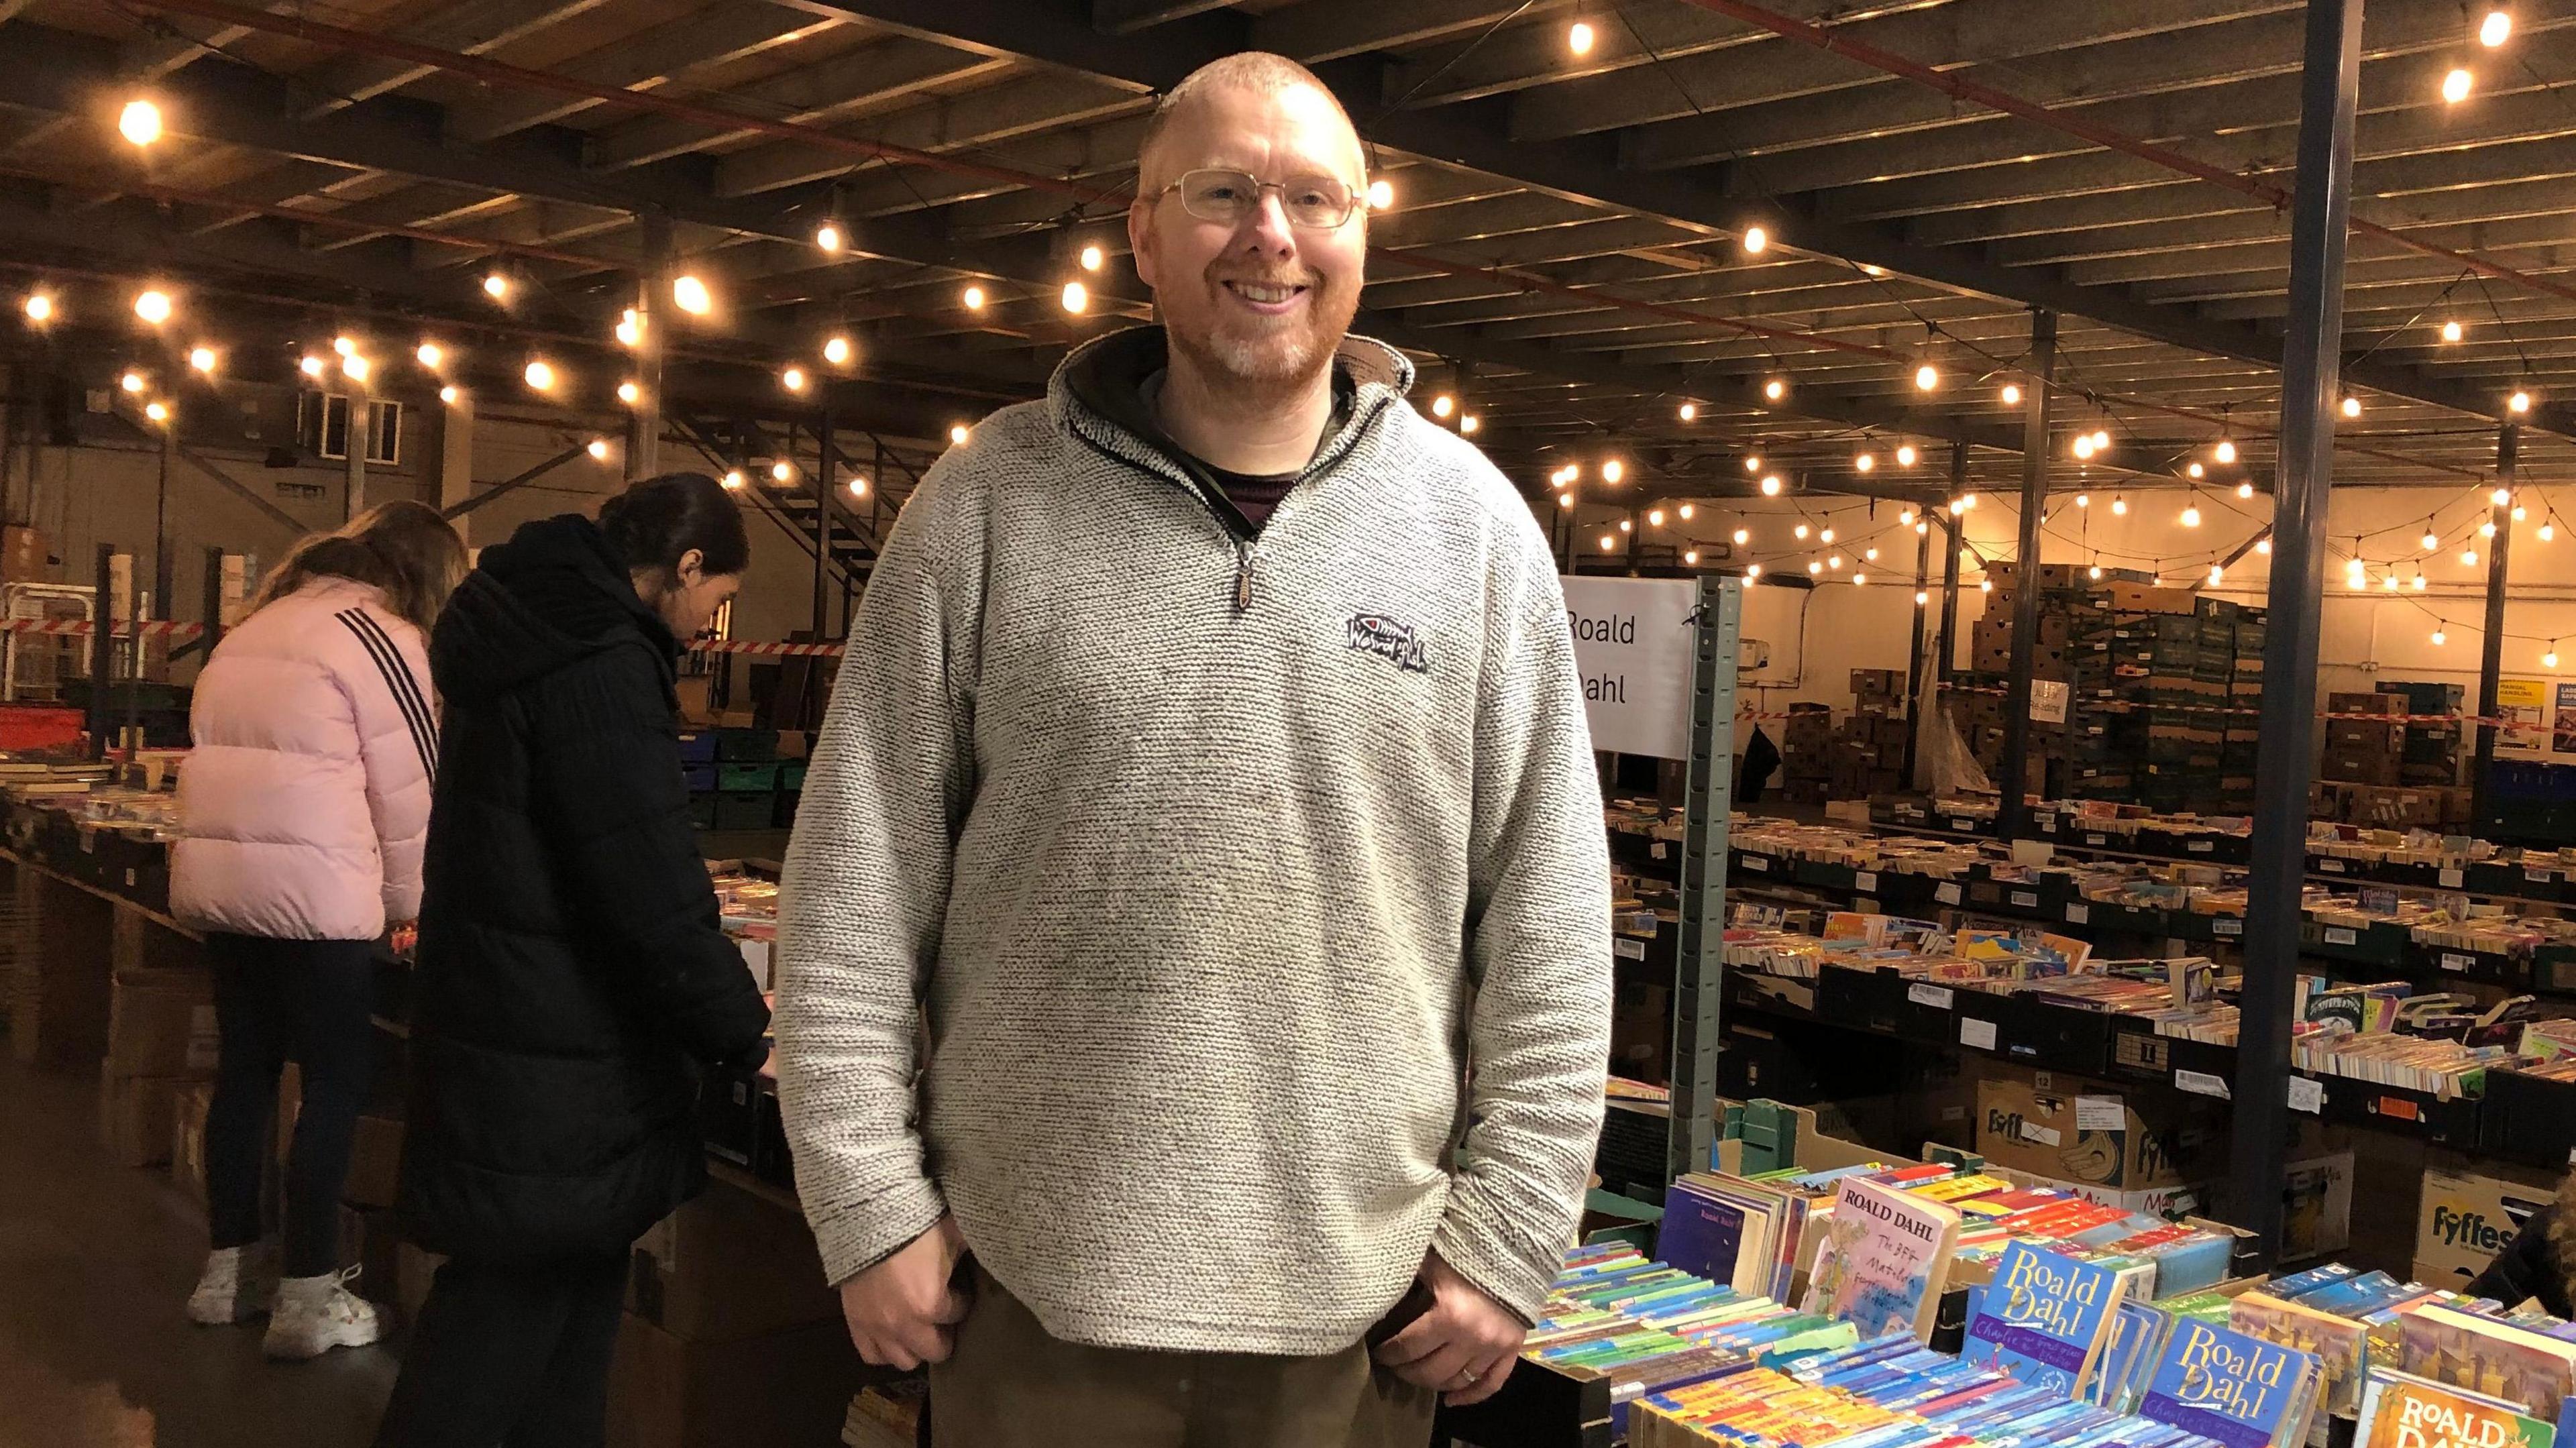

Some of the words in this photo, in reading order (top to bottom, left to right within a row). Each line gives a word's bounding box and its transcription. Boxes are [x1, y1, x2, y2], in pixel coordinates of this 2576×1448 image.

[1348, 620, 1397, 659] Weird
[1568, 611, 1635, 644] Roald
[2038, 1077, 2049, 1087] 12
[1845, 1190, 1892, 1221] ROALD
[1894, 1213, 1933, 1243] DAHL
[2432, 1206, 2514, 1251] fyffes
[1866, 1257, 1915, 1288] Matilda
[1878, 1234, 1892, 1251] The
[1894, 1243, 1919, 1264] BFG
[2002, 1248, 2101, 1306] Roald
[2002, 1286, 2083, 1337] Dahl
[2176, 1324, 2287, 1388] Roald
[2174, 1364, 2267, 1419] Dahl
[2399, 1396, 2506, 1448] ROALD
